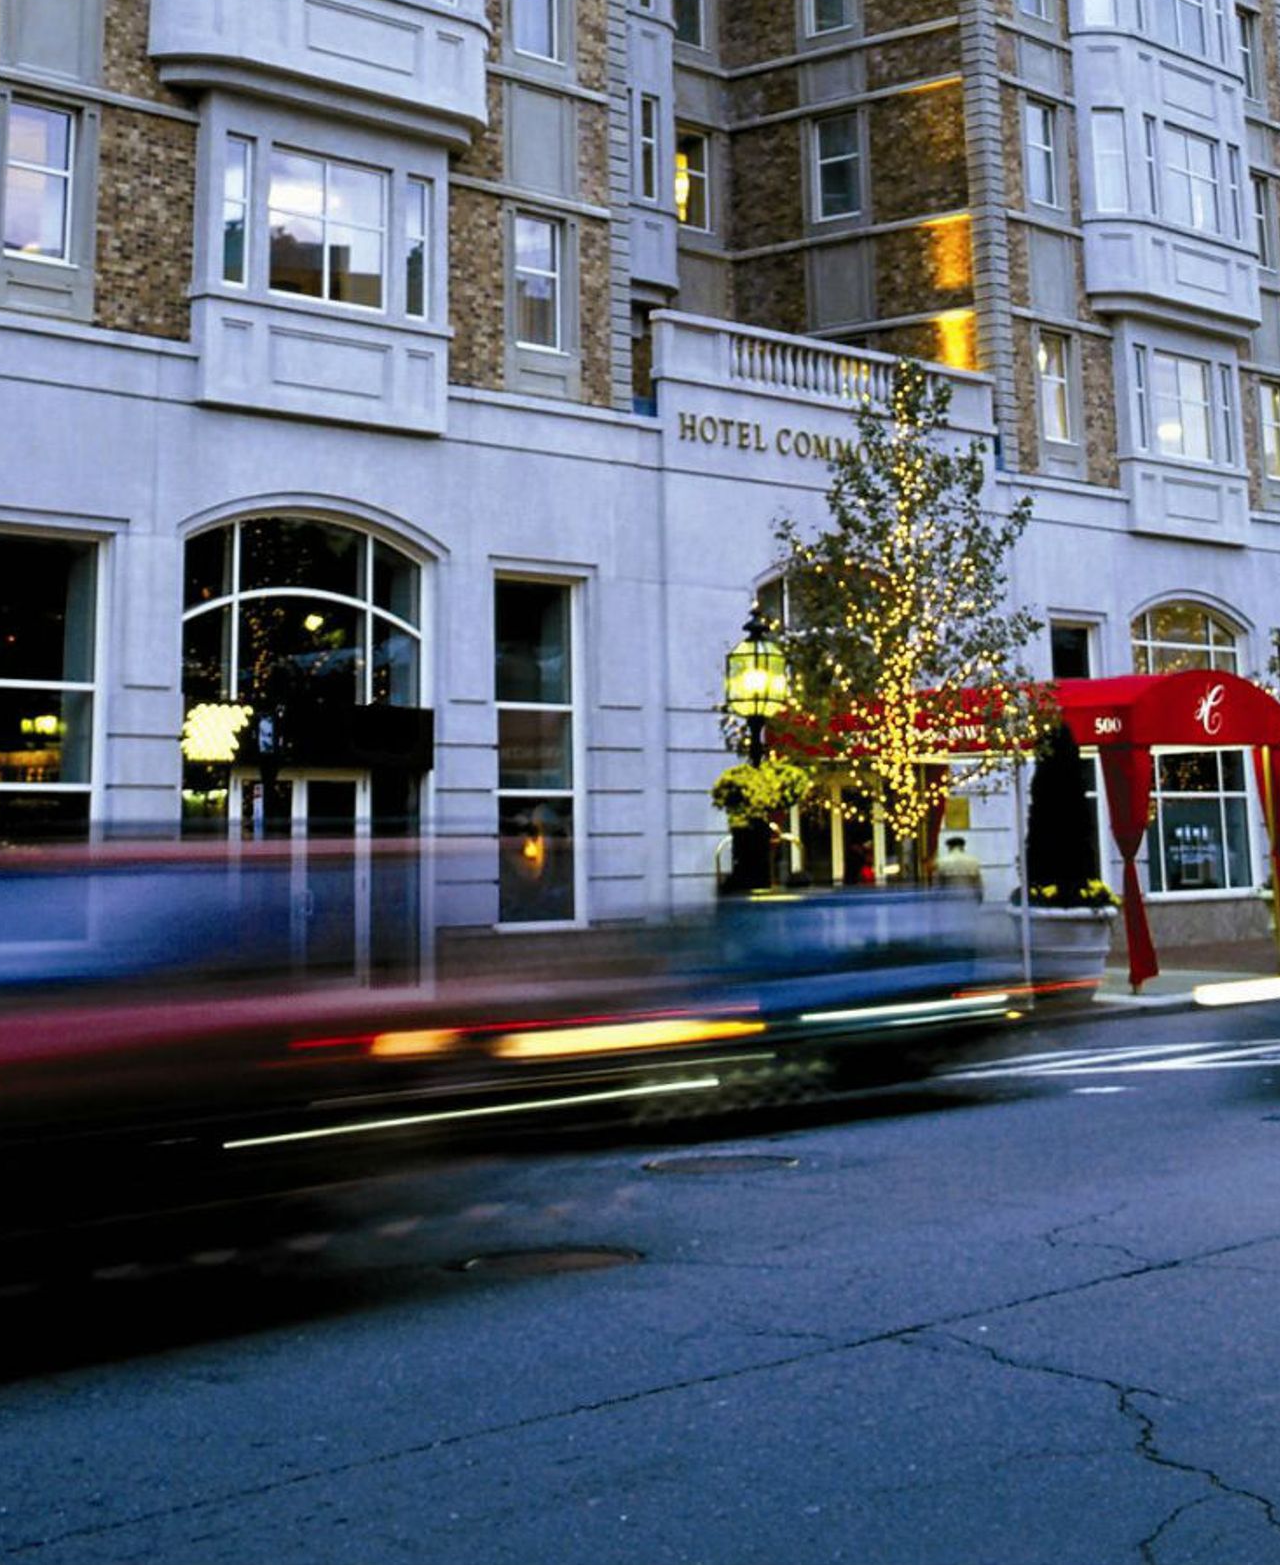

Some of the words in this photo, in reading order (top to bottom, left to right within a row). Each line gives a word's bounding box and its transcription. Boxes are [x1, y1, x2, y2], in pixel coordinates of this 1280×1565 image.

[677, 412, 768, 452] HOTEL
[775, 428, 874, 467] COMMO
[1094, 716, 1122, 735] 500
